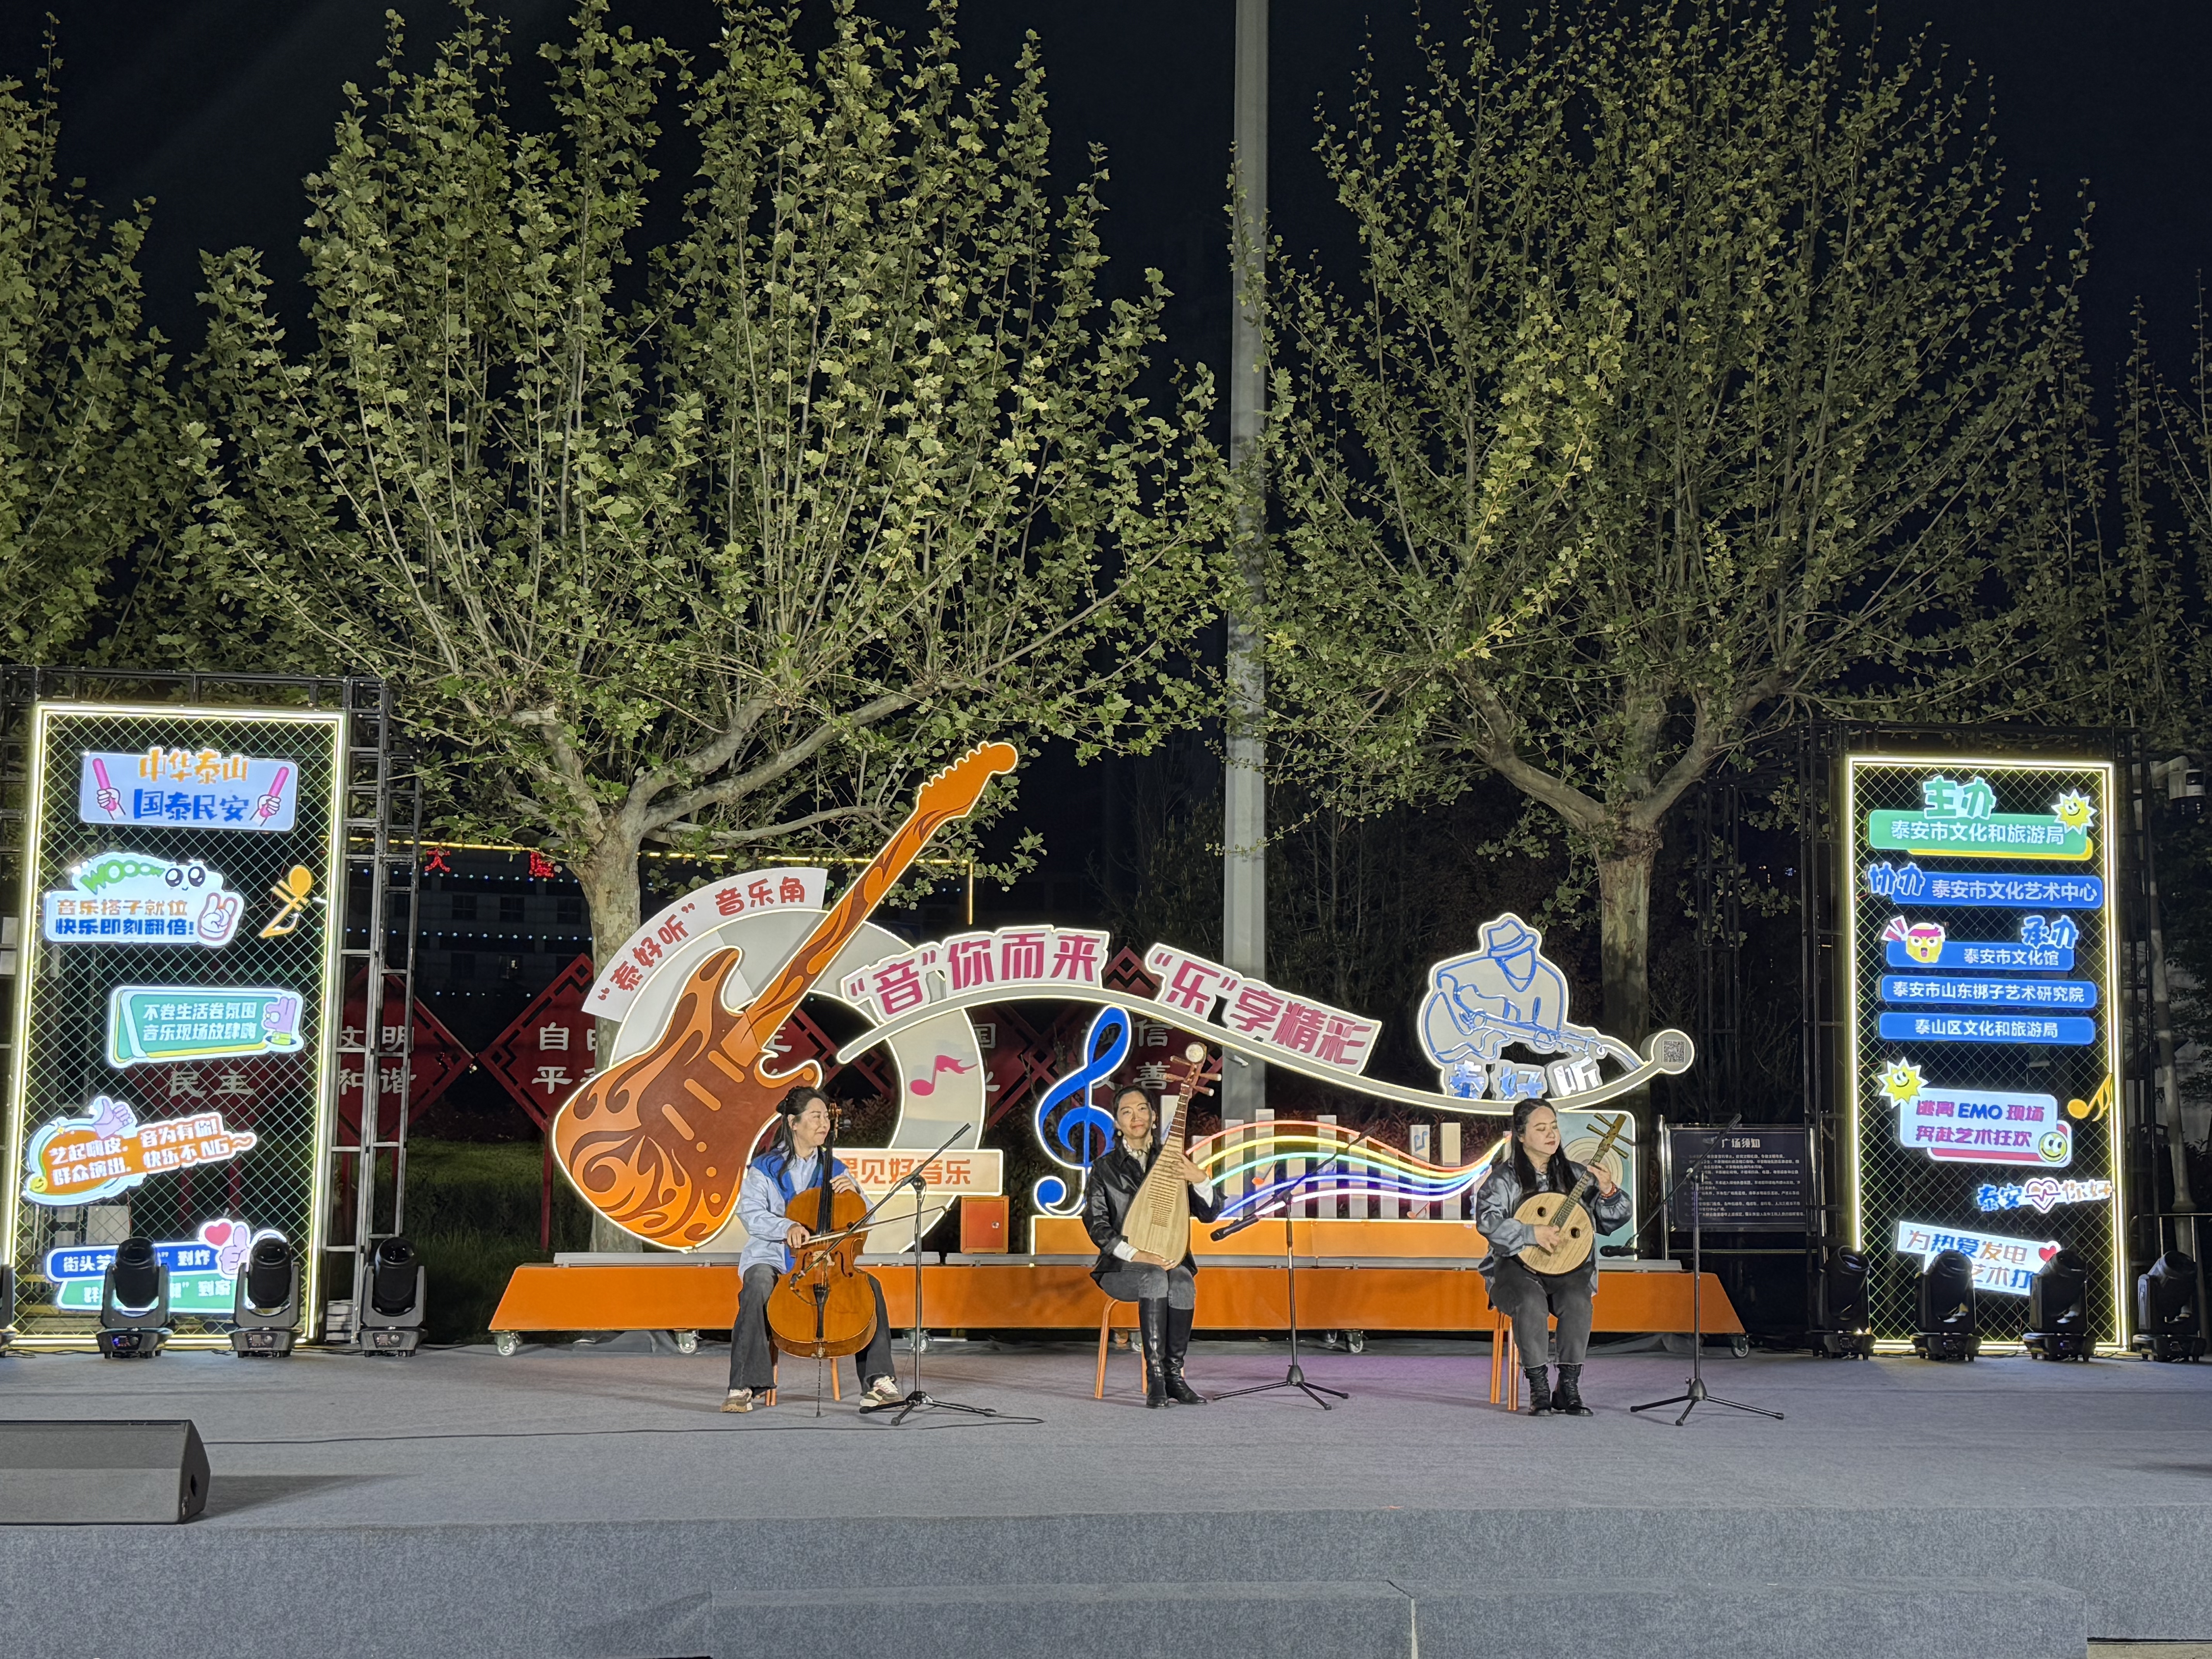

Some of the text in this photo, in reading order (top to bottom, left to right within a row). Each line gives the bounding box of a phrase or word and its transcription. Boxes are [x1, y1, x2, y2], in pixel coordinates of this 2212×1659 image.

[140, 749, 248, 784] 中华泰山
[134, 788, 249, 821] 国泰民安
[1925, 776, 1994, 818] 主办
[1891, 820, 2064, 845] 泰安市文化和旅游局
[1869, 863, 2097, 902] 协办 泰安市文化艺术中心
[57, 899, 187, 915] 音乐搭子就位
[56, 918, 194, 935] 快乐即刻翻倍!
[2023, 916, 2076, 948] 承办
[1964, 948, 2059, 965] 泰安市文化馆
[1893, 981, 2085, 1002] 泰安市山东梆子艺术研究院
[143, 1002, 257, 1020] 不卷生活卷氛围
[143, 1022, 257, 1041] 音乐现场放肆嗨
[341, 1025, 414, 1052] 文明
[1915, 1019, 2058, 1037] 泰山区文化和旅游局
[169, 1068, 254, 1097] 民主
[1958, 1103, 2003, 1120] EMO
[1721, 1138, 1760, 1148] 广场须知
[1978, 1186, 2023, 1211] 泰安
[1907, 1230, 2027, 1264] 为热爱发电
